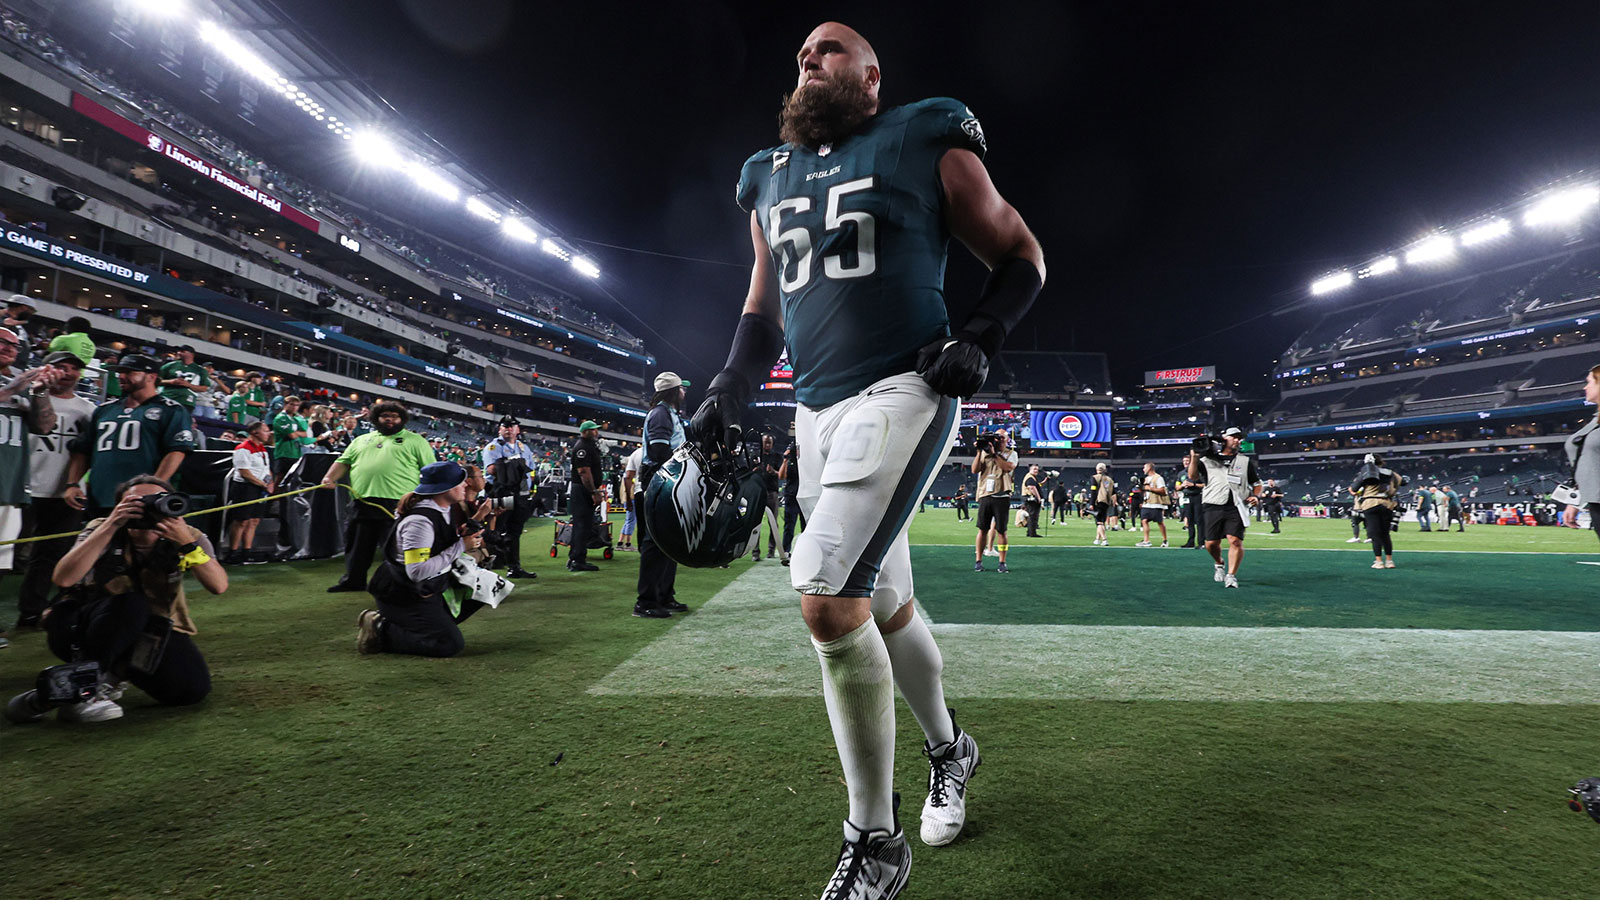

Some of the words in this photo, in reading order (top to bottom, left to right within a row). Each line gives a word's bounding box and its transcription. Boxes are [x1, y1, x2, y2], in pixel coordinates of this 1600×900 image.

[165, 144, 209, 176] Lincoln
[210, 167, 257, 200] Financial
[257, 191, 281, 212] Field
[805, 165, 842, 182] EAGLES
[769, 177, 876, 293] 65
[7, 231, 48, 252] GAME
[50, 244, 63, 257] IS
[65, 249, 133, 278] PRESENTED
[133, 271, 150, 283] BY
[1156, 367, 1203, 380] FIRSTRUST
[97, 420, 141, 452] 20
